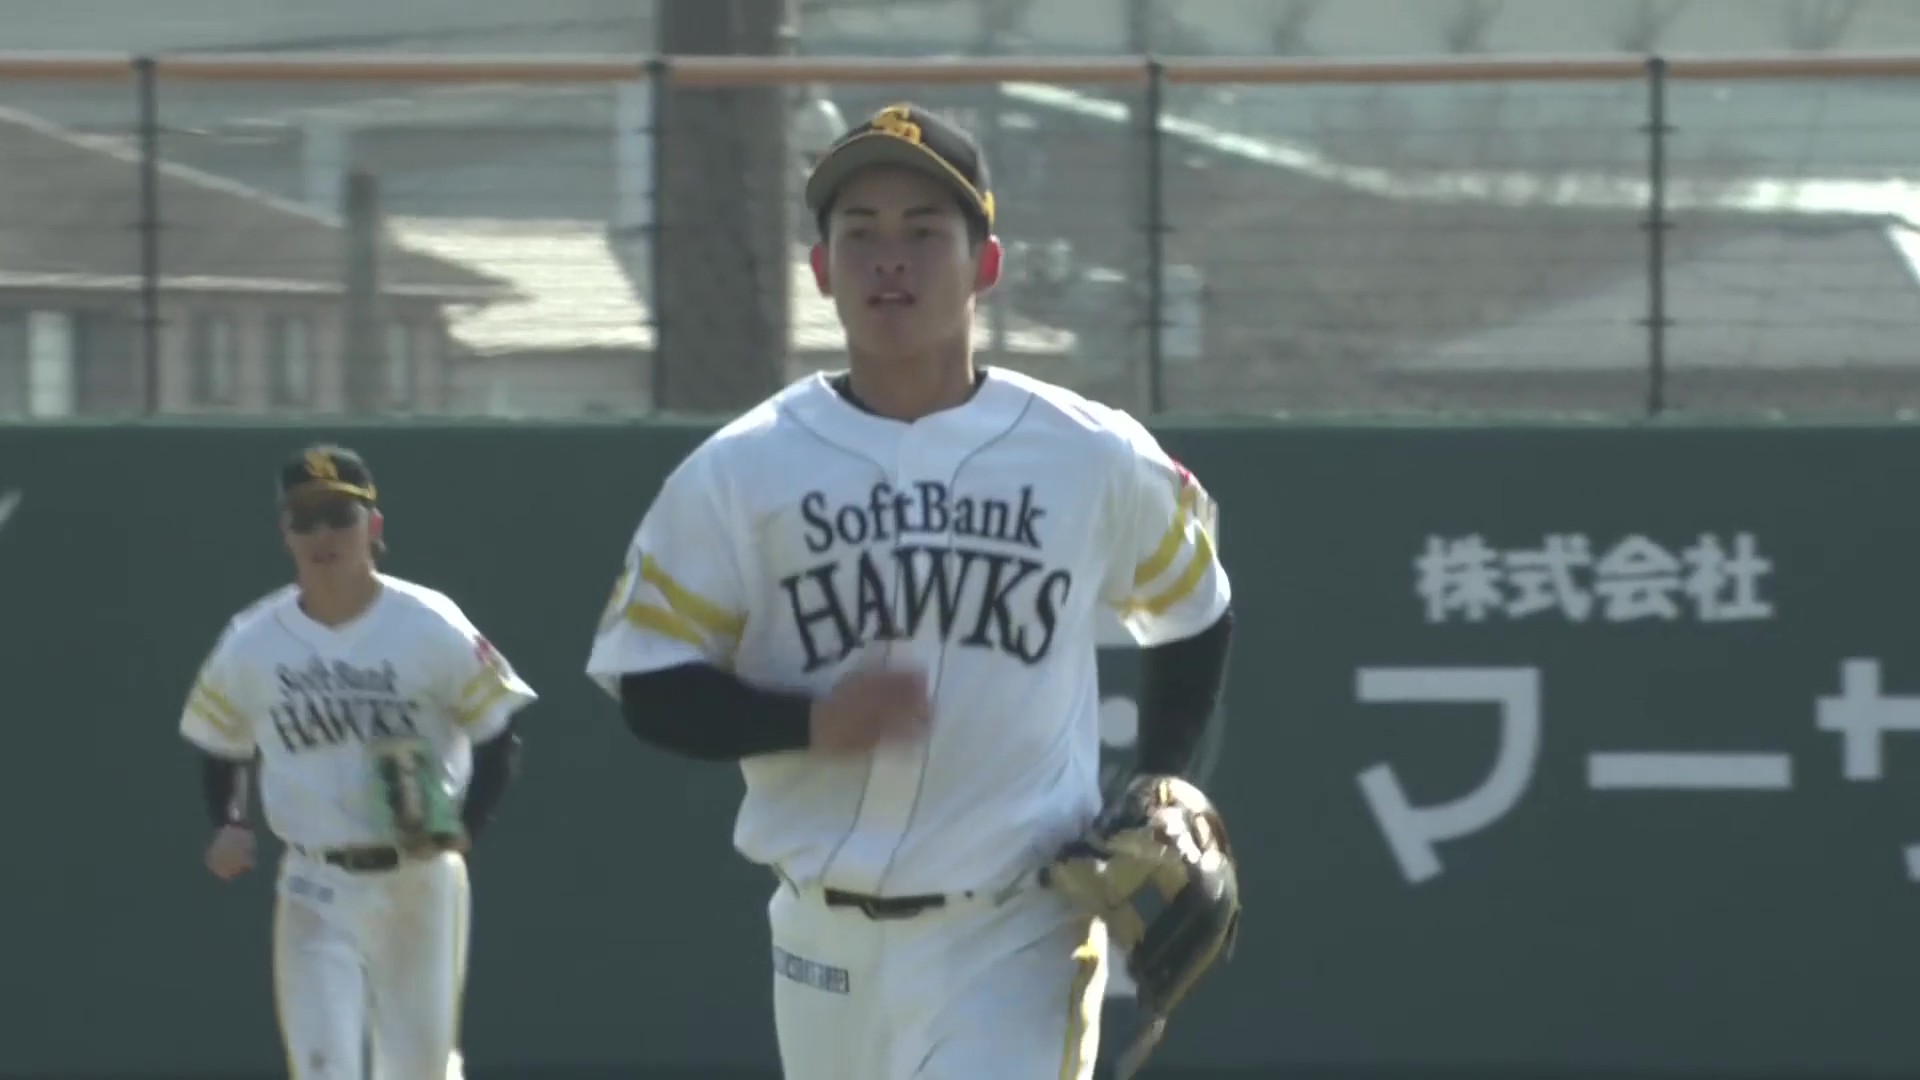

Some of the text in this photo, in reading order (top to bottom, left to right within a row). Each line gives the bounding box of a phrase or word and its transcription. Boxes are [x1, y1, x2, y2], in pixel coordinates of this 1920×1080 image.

[802, 480, 1046, 554] SoftBank
[780, 545, 1072, 674] HAWKS
[1414, 532, 1775, 622] 株式会社
